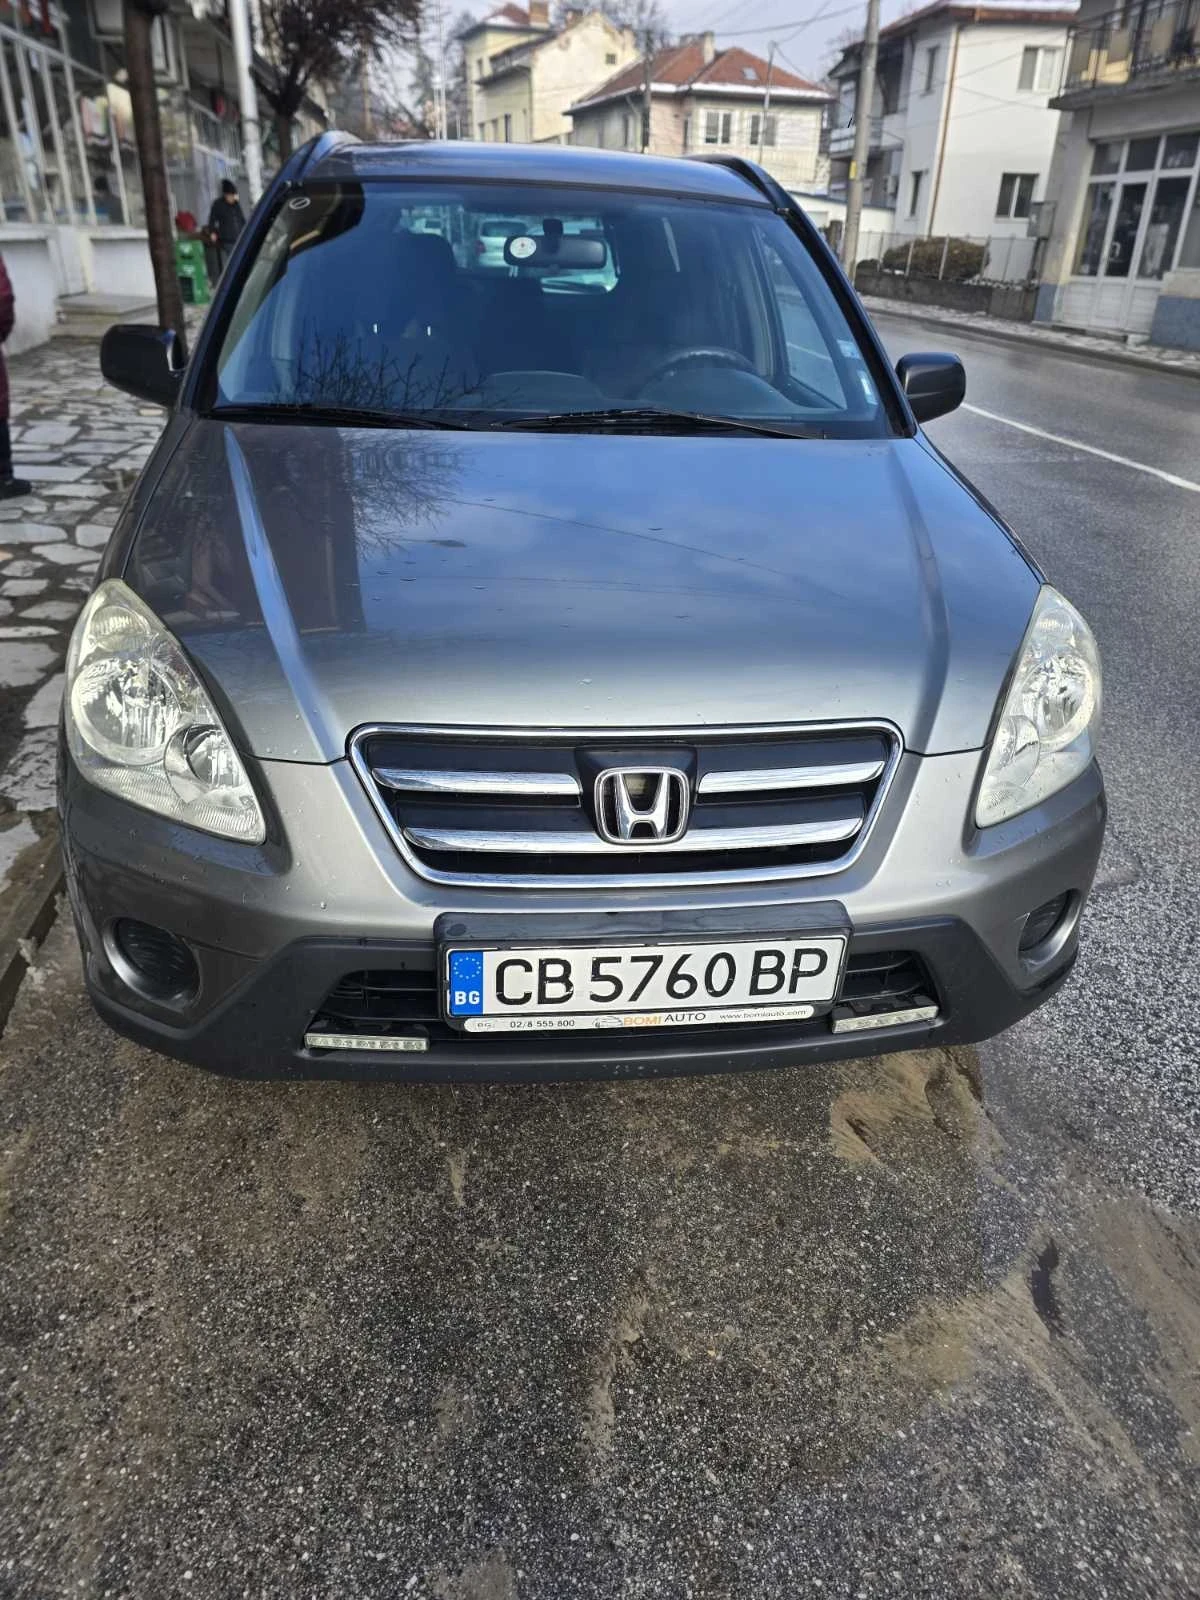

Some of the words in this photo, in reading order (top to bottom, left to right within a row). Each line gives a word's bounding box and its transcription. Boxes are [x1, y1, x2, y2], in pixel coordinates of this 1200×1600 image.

[495, 957, 574, 1006] CB
[589, 951, 737, 1003] 5760
[749, 947, 829, 996] BP
[455, 990, 481, 1006] BG
[536, 1019, 554, 1028] 555
[624, 1015, 662, 1027] BOMI
[664, 1012, 707, 1023] AUTO
[719, 1009, 807, 1020] www.bomiauto.com
